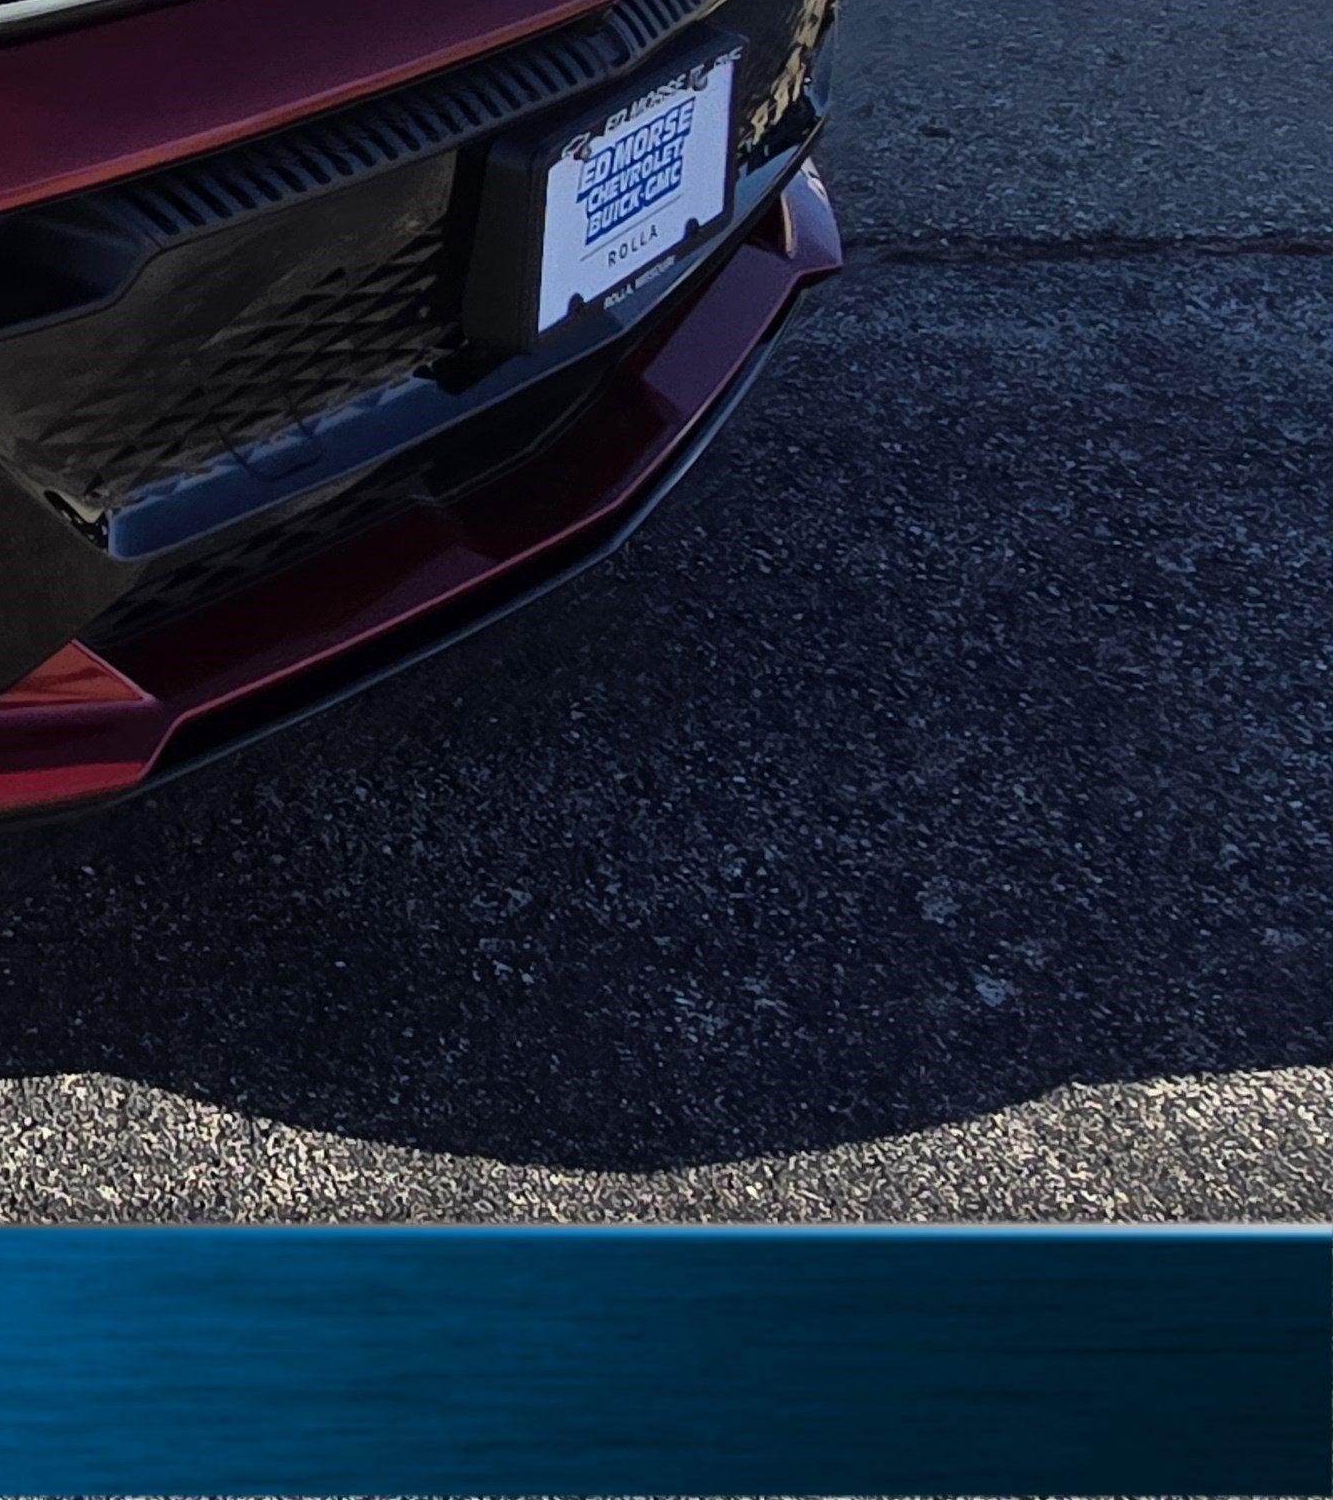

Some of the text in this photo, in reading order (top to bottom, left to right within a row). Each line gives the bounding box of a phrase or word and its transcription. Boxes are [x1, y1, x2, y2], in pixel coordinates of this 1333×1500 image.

[582, 99, 695, 193] ED MORSE
[587, 136, 684, 213] CHEVROLET
[608, 224, 658, 267] ROLLA
